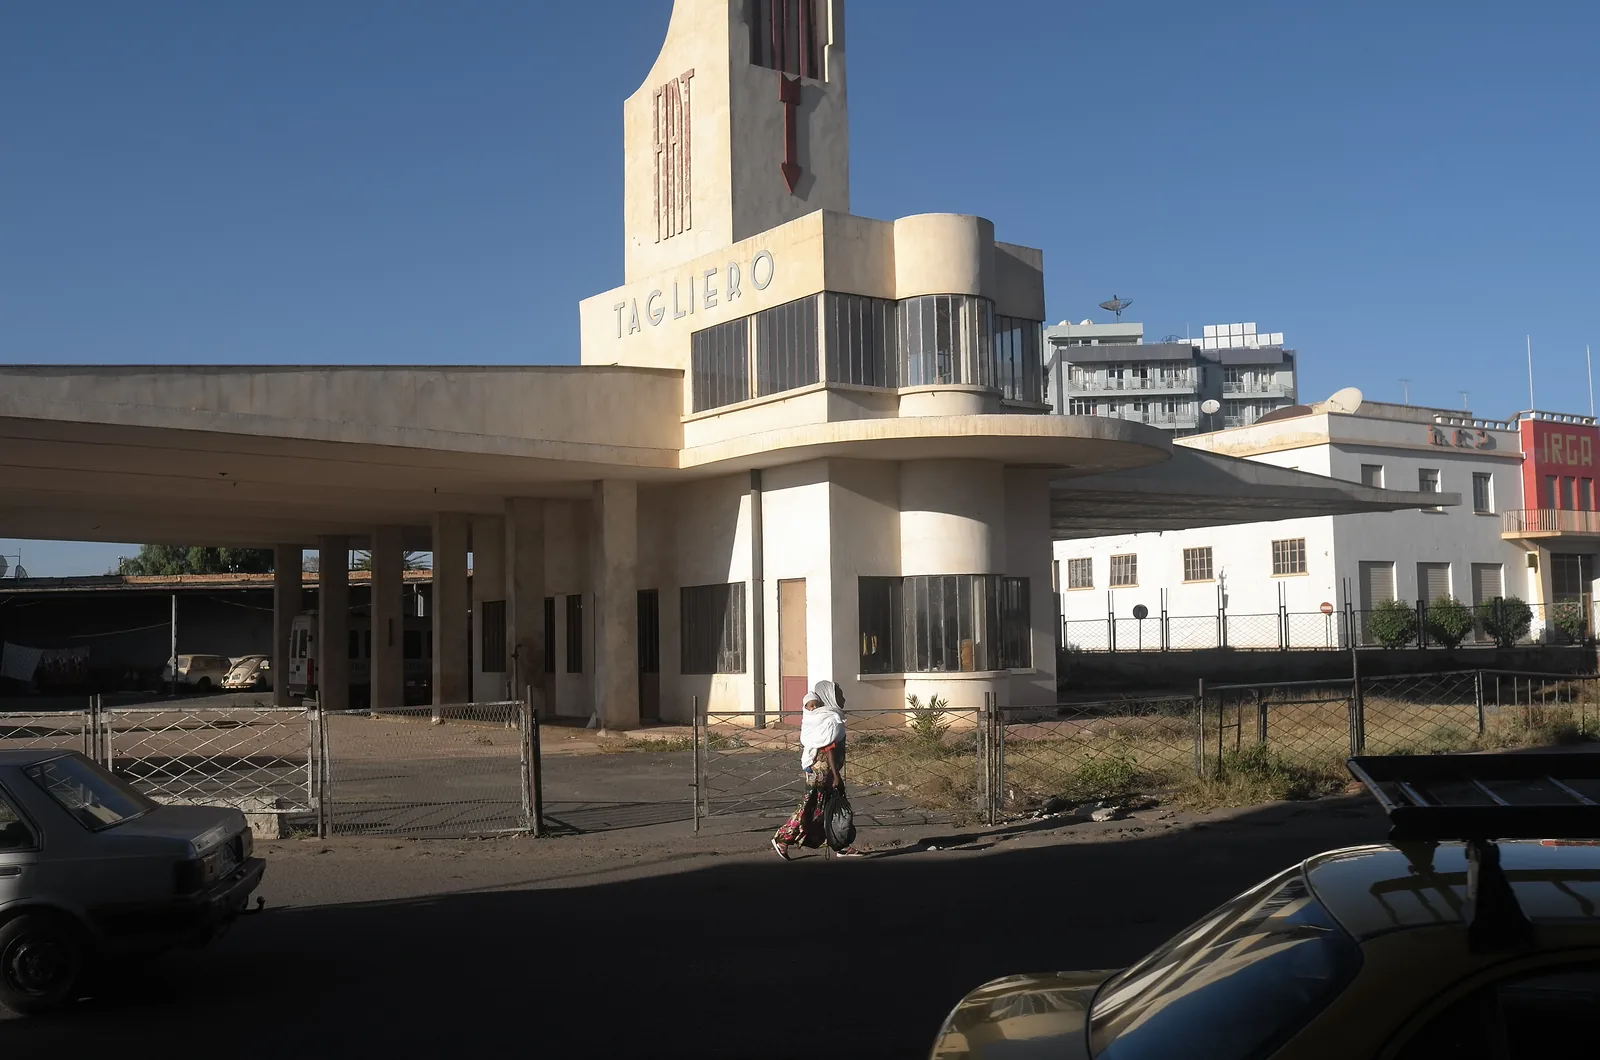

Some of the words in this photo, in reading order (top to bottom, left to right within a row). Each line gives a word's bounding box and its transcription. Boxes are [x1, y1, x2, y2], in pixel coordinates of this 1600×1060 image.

[653, 69, 695, 243] FIAT
[614, 250, 774, 338] TAGLIERO
[1543, 432, 1592, 466] IRGA
